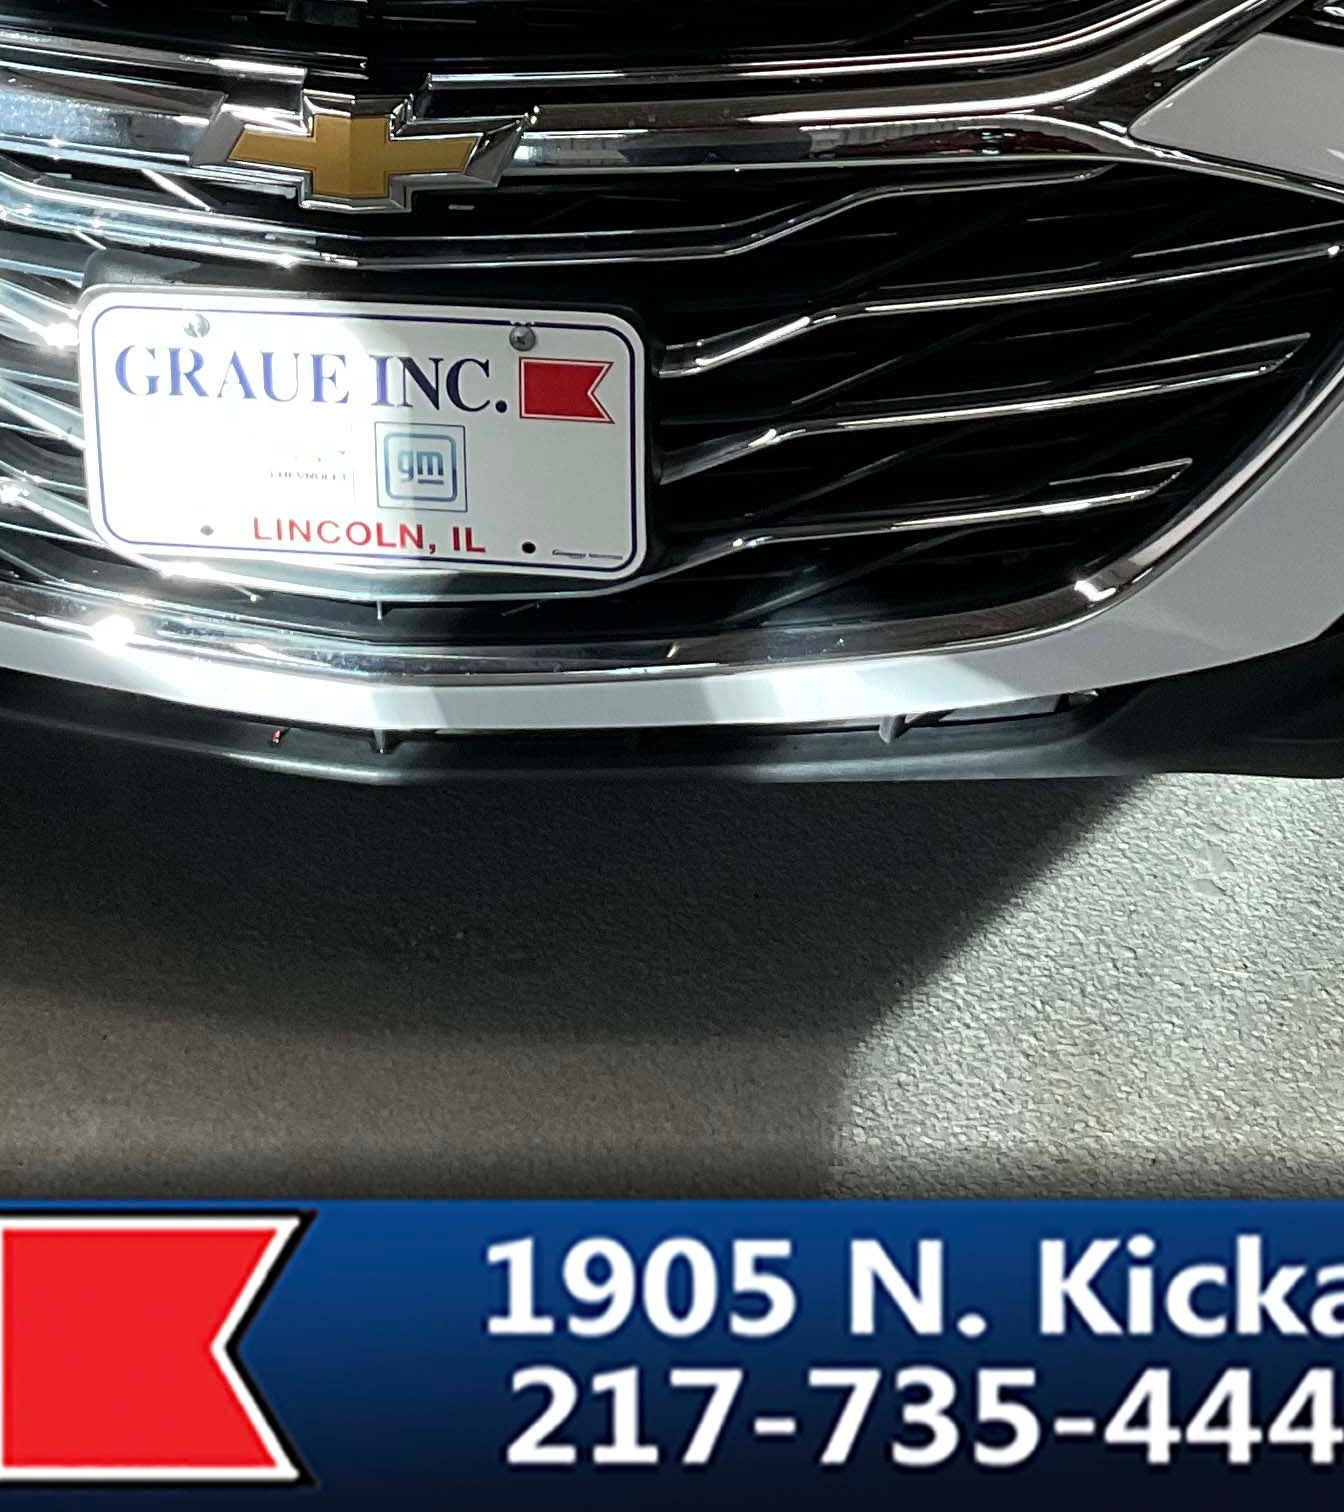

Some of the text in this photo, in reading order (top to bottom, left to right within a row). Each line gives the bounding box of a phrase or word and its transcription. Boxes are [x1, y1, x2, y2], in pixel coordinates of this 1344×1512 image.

[114, 343, 508, 414] GRAUE INC.
[397, 449, 445, 486] gm
[253, 517, 487, 555] LINCOLN, IL
